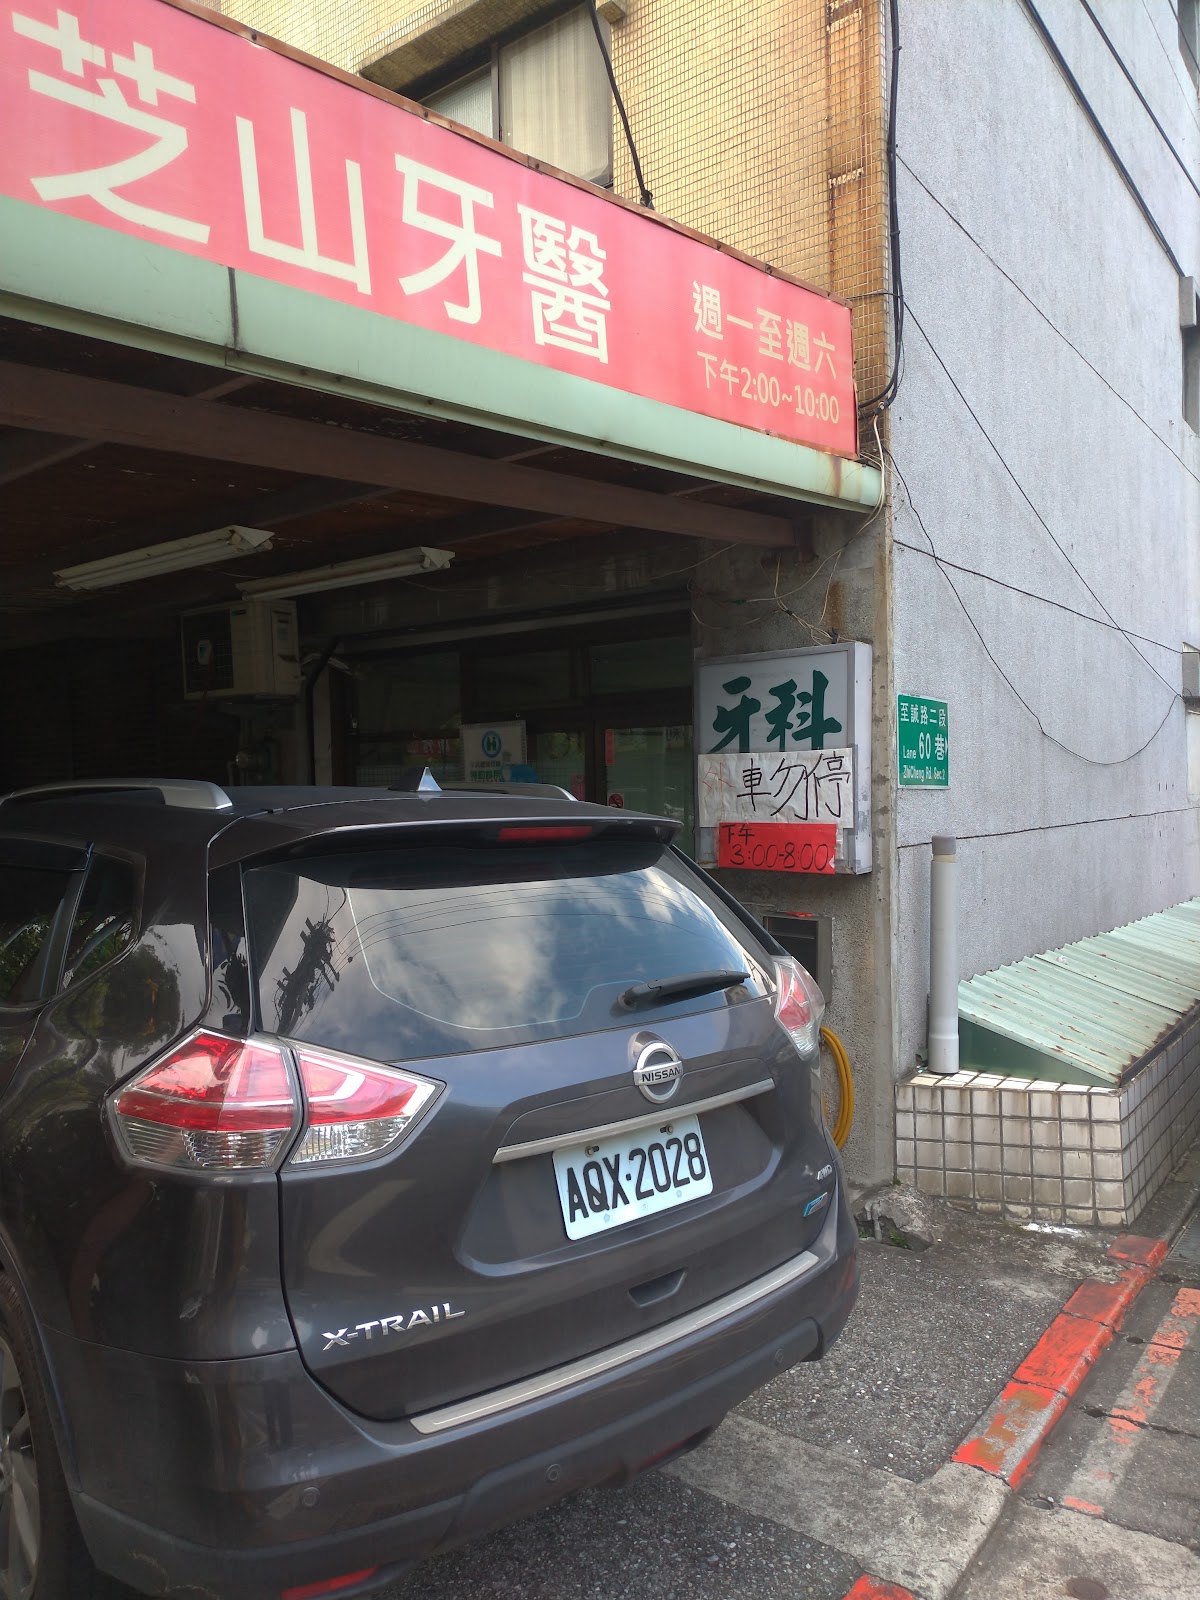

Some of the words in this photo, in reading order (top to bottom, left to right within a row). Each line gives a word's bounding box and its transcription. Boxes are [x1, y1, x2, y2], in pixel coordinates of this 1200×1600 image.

[12, 8, 611, 365] 芝山牙醫
[692, 280, 837, 380] 週一至週六
[706, 669, 842, 753] 牙科
[900, 702, 946, 727] 至誠路二段
[903, 746, 917, 759] Lane
[918, 731, 931, 760] 60
[934, 733, 945, 761] 巷
[722, 823, 755, 846] 下午
[641, 1067, 681, 1083] NISSAN
[321, 1302, 466, 1351] X-TRAIL
